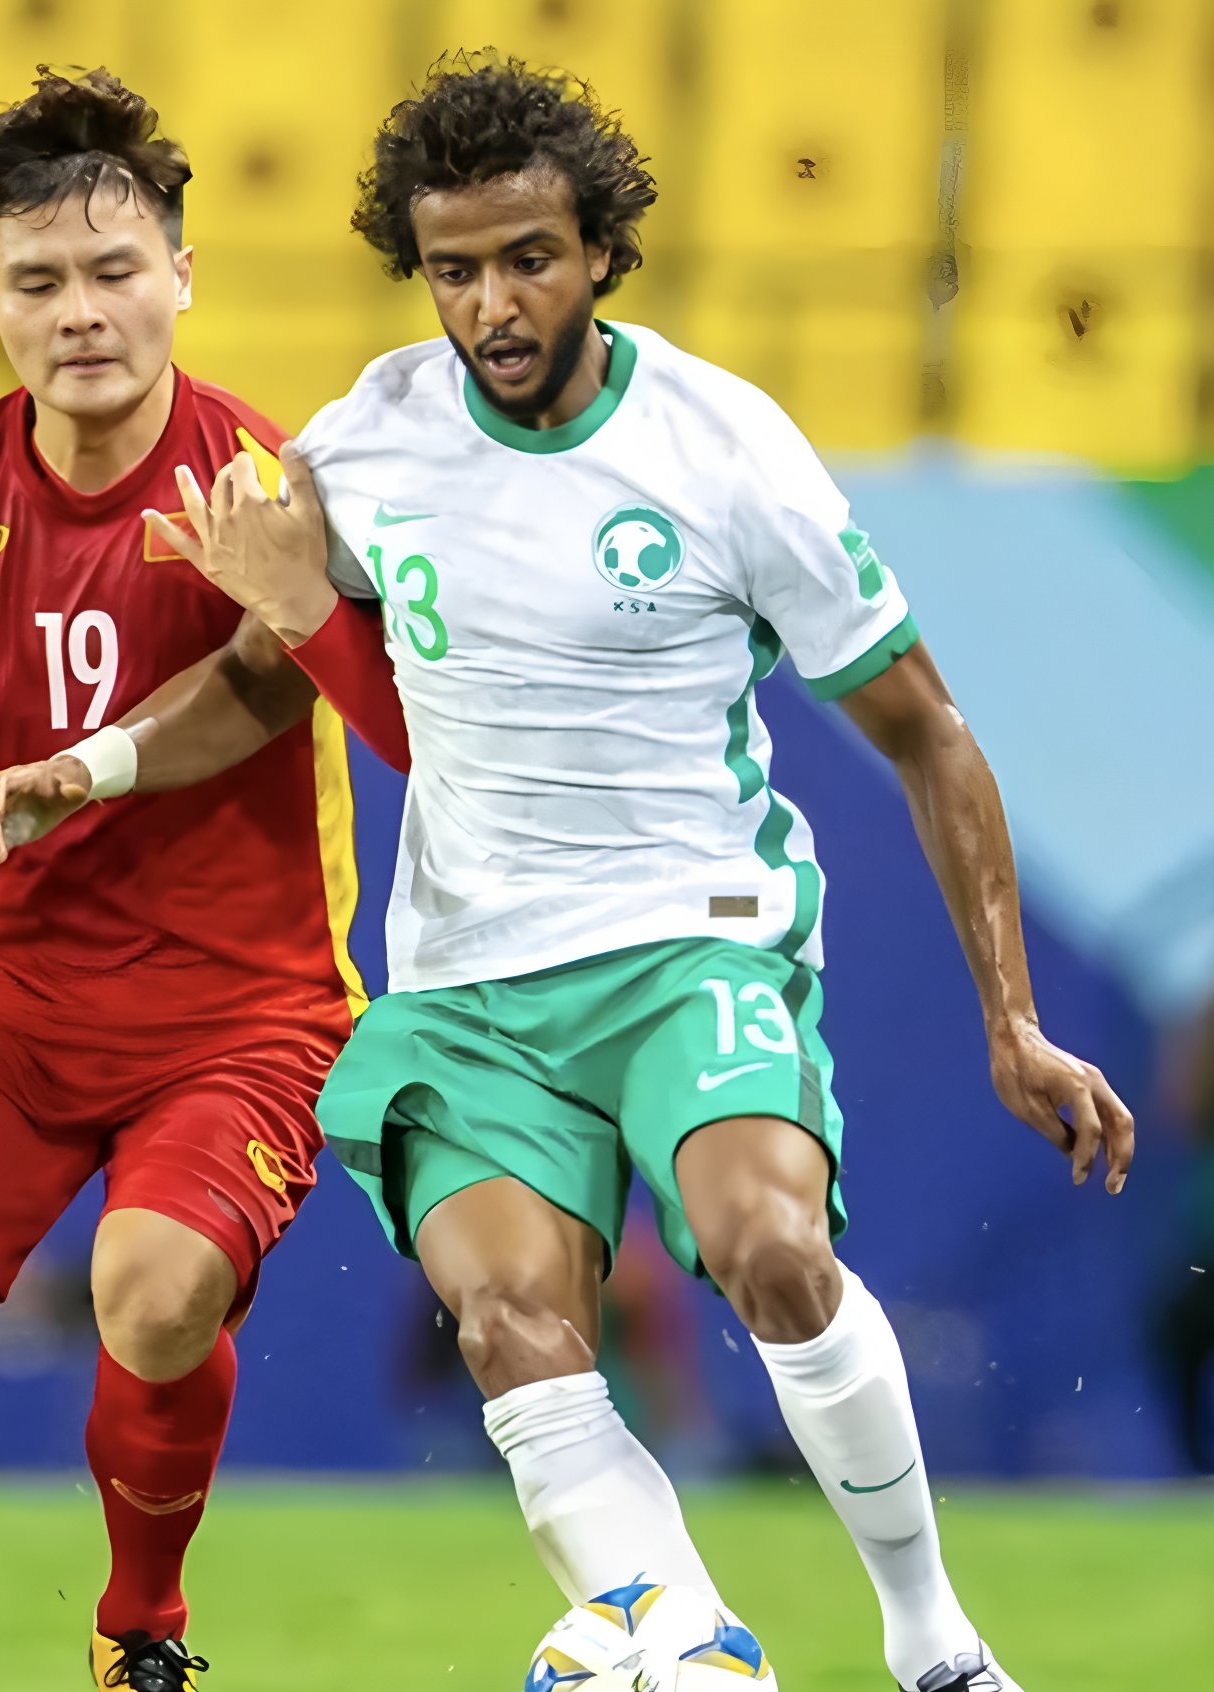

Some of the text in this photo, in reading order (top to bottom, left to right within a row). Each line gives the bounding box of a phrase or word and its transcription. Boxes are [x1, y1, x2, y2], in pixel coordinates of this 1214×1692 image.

[367, 544, 449, 662] 13
[35, 609, 119, 730] 19
[698, 978, 799, 1055] 13
